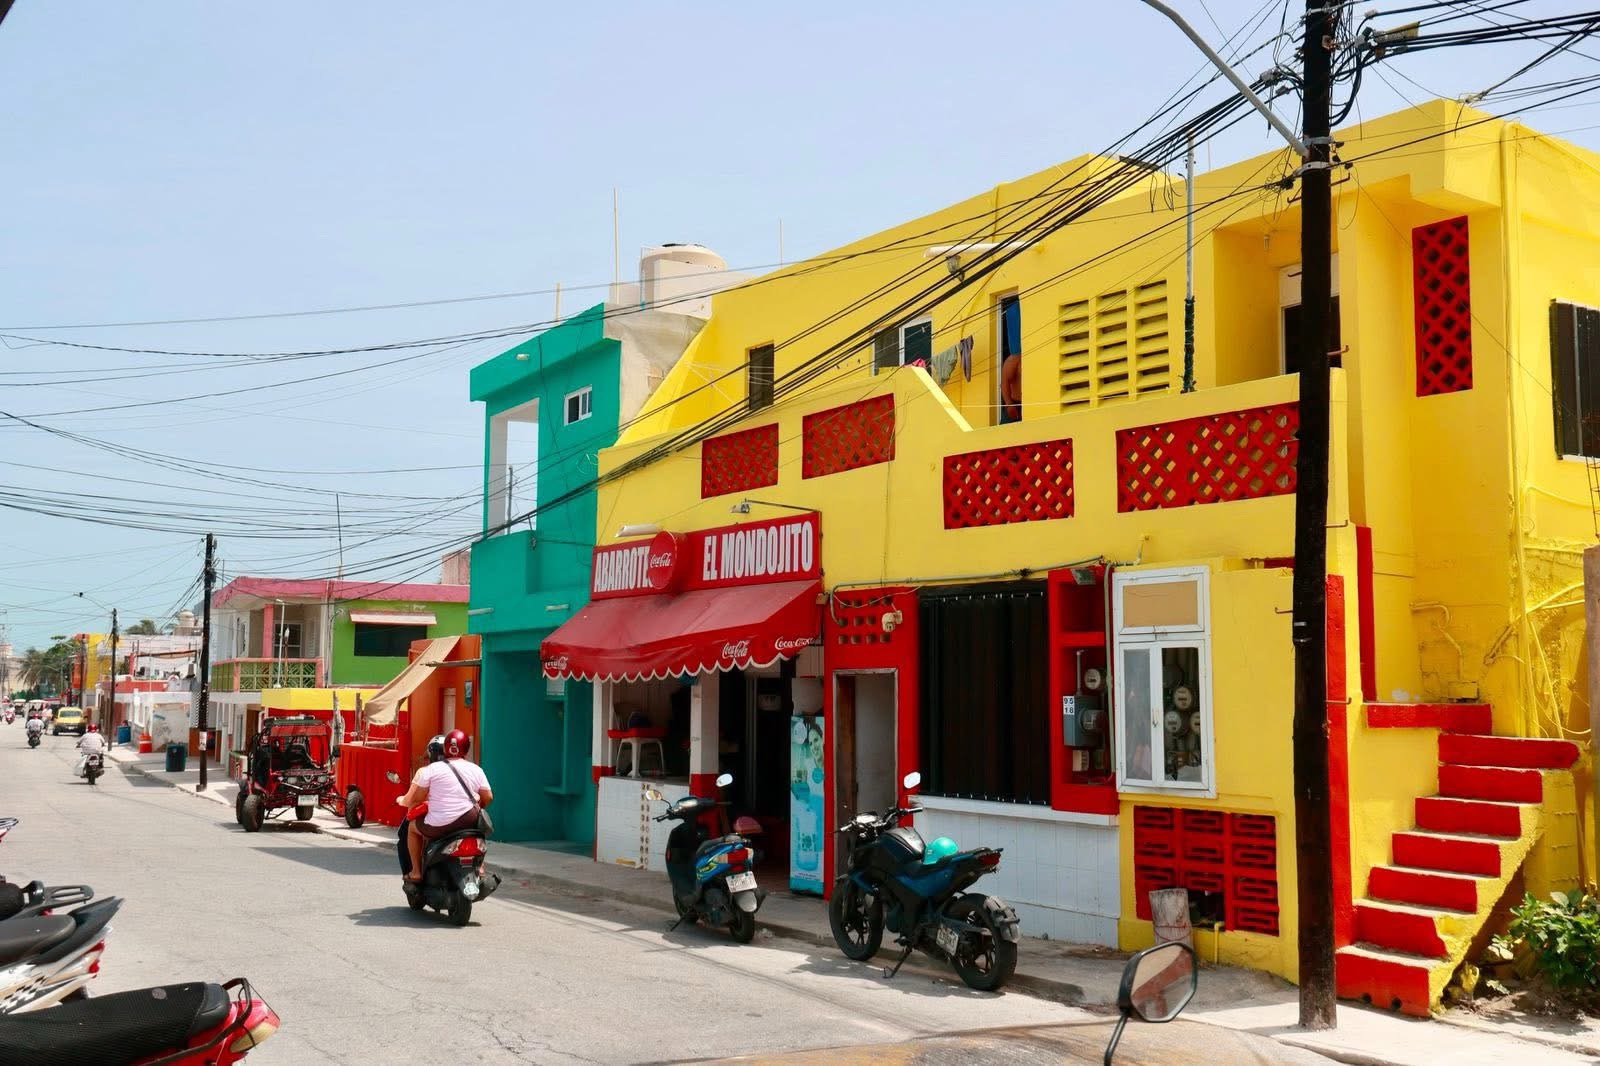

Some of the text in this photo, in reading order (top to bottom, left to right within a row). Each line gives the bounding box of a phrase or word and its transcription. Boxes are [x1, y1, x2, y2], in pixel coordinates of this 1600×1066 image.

[594, 545, 653, 592] ABARROTE
[703, 520, 813, 581] EL MONDOJITO
